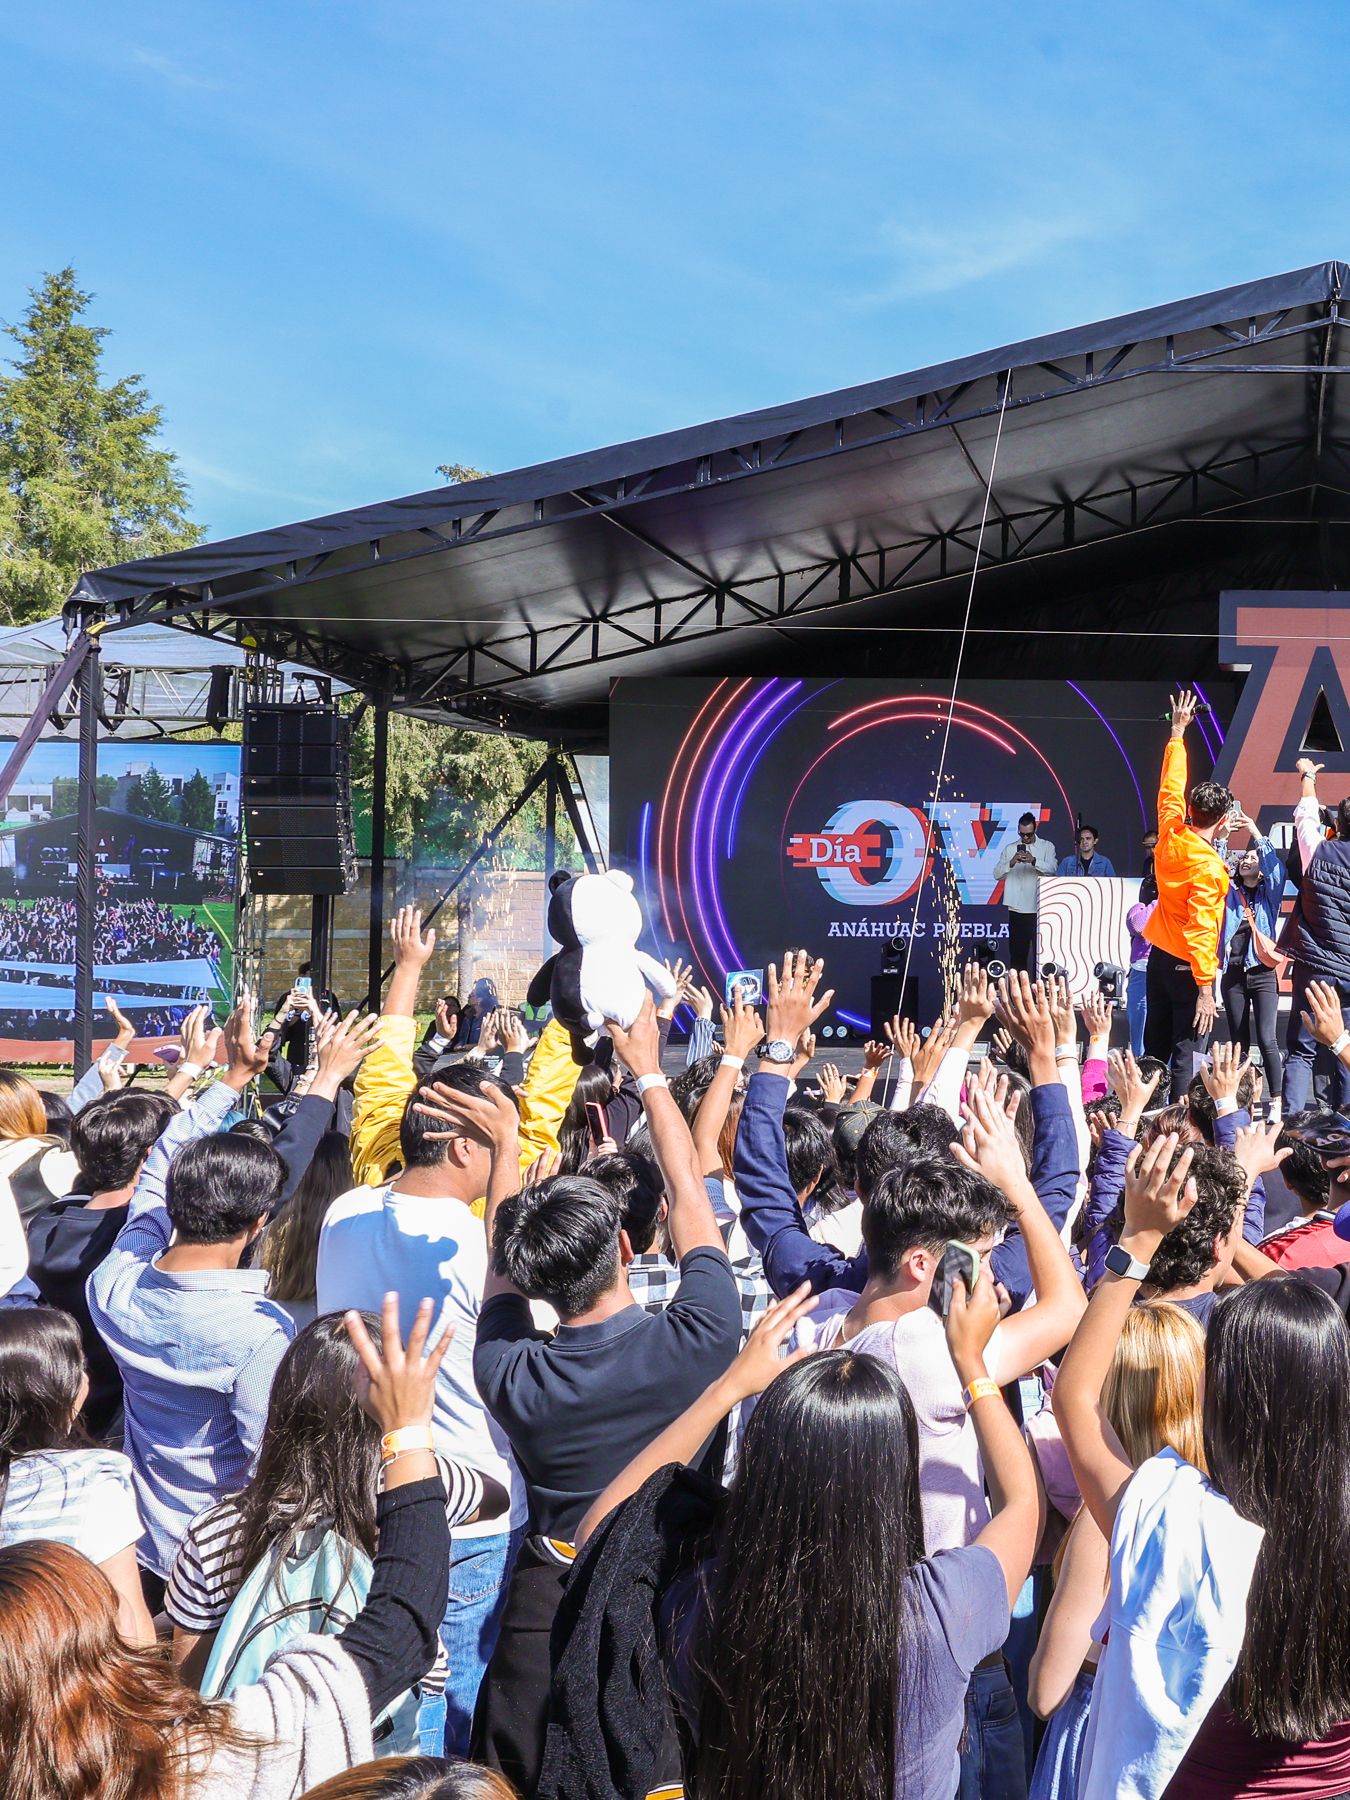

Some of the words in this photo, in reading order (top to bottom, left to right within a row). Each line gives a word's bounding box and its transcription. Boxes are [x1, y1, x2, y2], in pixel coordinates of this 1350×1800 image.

[809, 837, 862, 863] Día
[816, 800, 1051, 905] OV
[827, 918, 926, 937] ANÁHUAC
